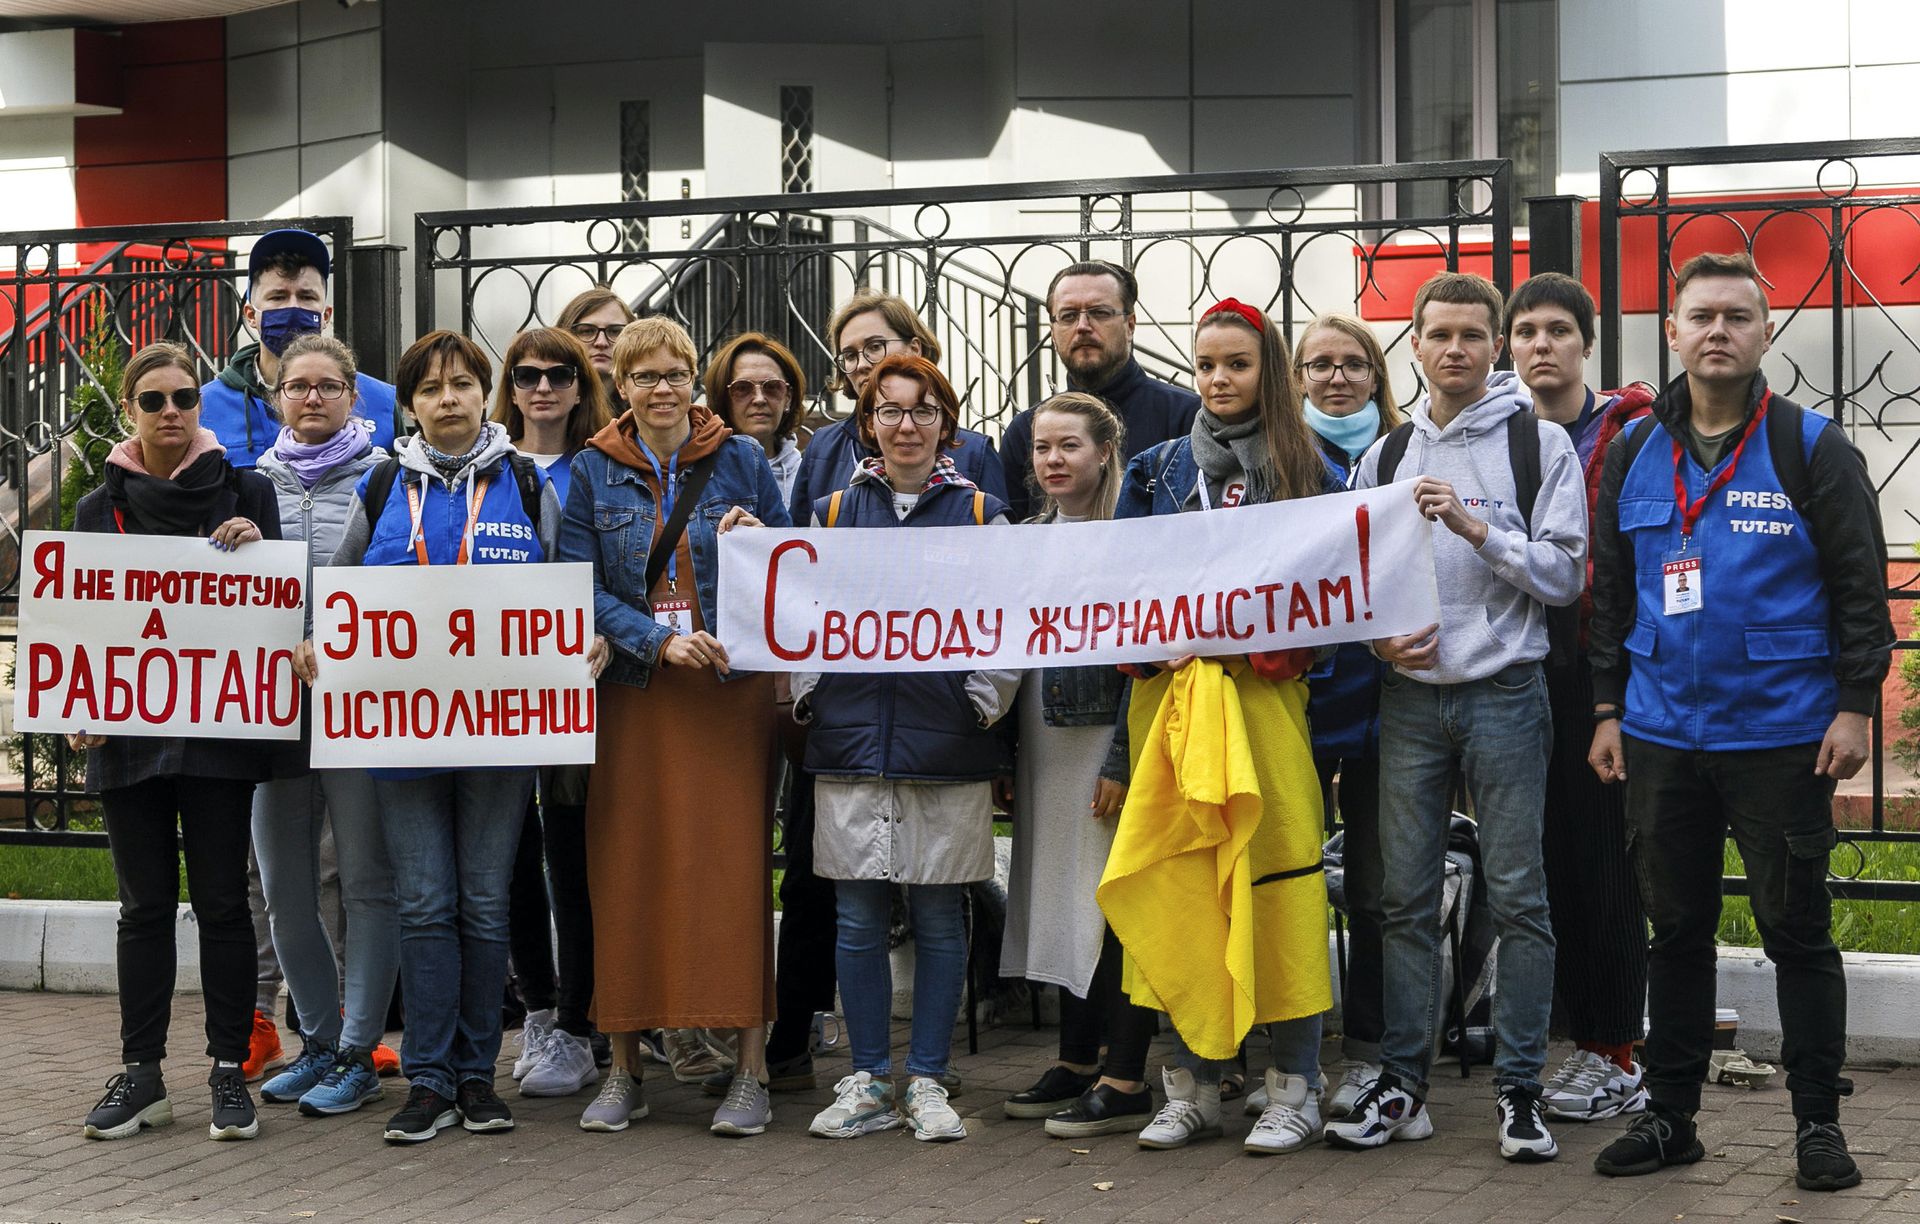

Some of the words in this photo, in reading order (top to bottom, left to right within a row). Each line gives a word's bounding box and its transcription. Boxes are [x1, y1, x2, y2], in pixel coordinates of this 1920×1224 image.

[473, 521, 533, 541] PRESS
[1730, 519, 1795, 536] TUT.BY
[478, 546, 530, 562] TUT.BY
[1666, 560, 1697, 572] PRESS
[33, 541, 65, 599] Я
[73, 569, 115, 601] НЕ
[124, 570, 304, 610] ПРОТЕСТУЮ,
[764, 539, 1003, 662] СВОБОДУ
[1026, 503, 1374, 657] ЖУРНАЛИСТАМ!
[656, 602, 688, 610] PRESS
[141, 608, 168, 640] А
[323, 591, 418, 661] ЭТО
[448, 608, 475, 657] Я
[501, 607, 584, 657] ПРИ
[27, 642, 300, 727] РАБОТАЮ
[323, 687, 595, 740] ИСПОЛНЕНИИ
